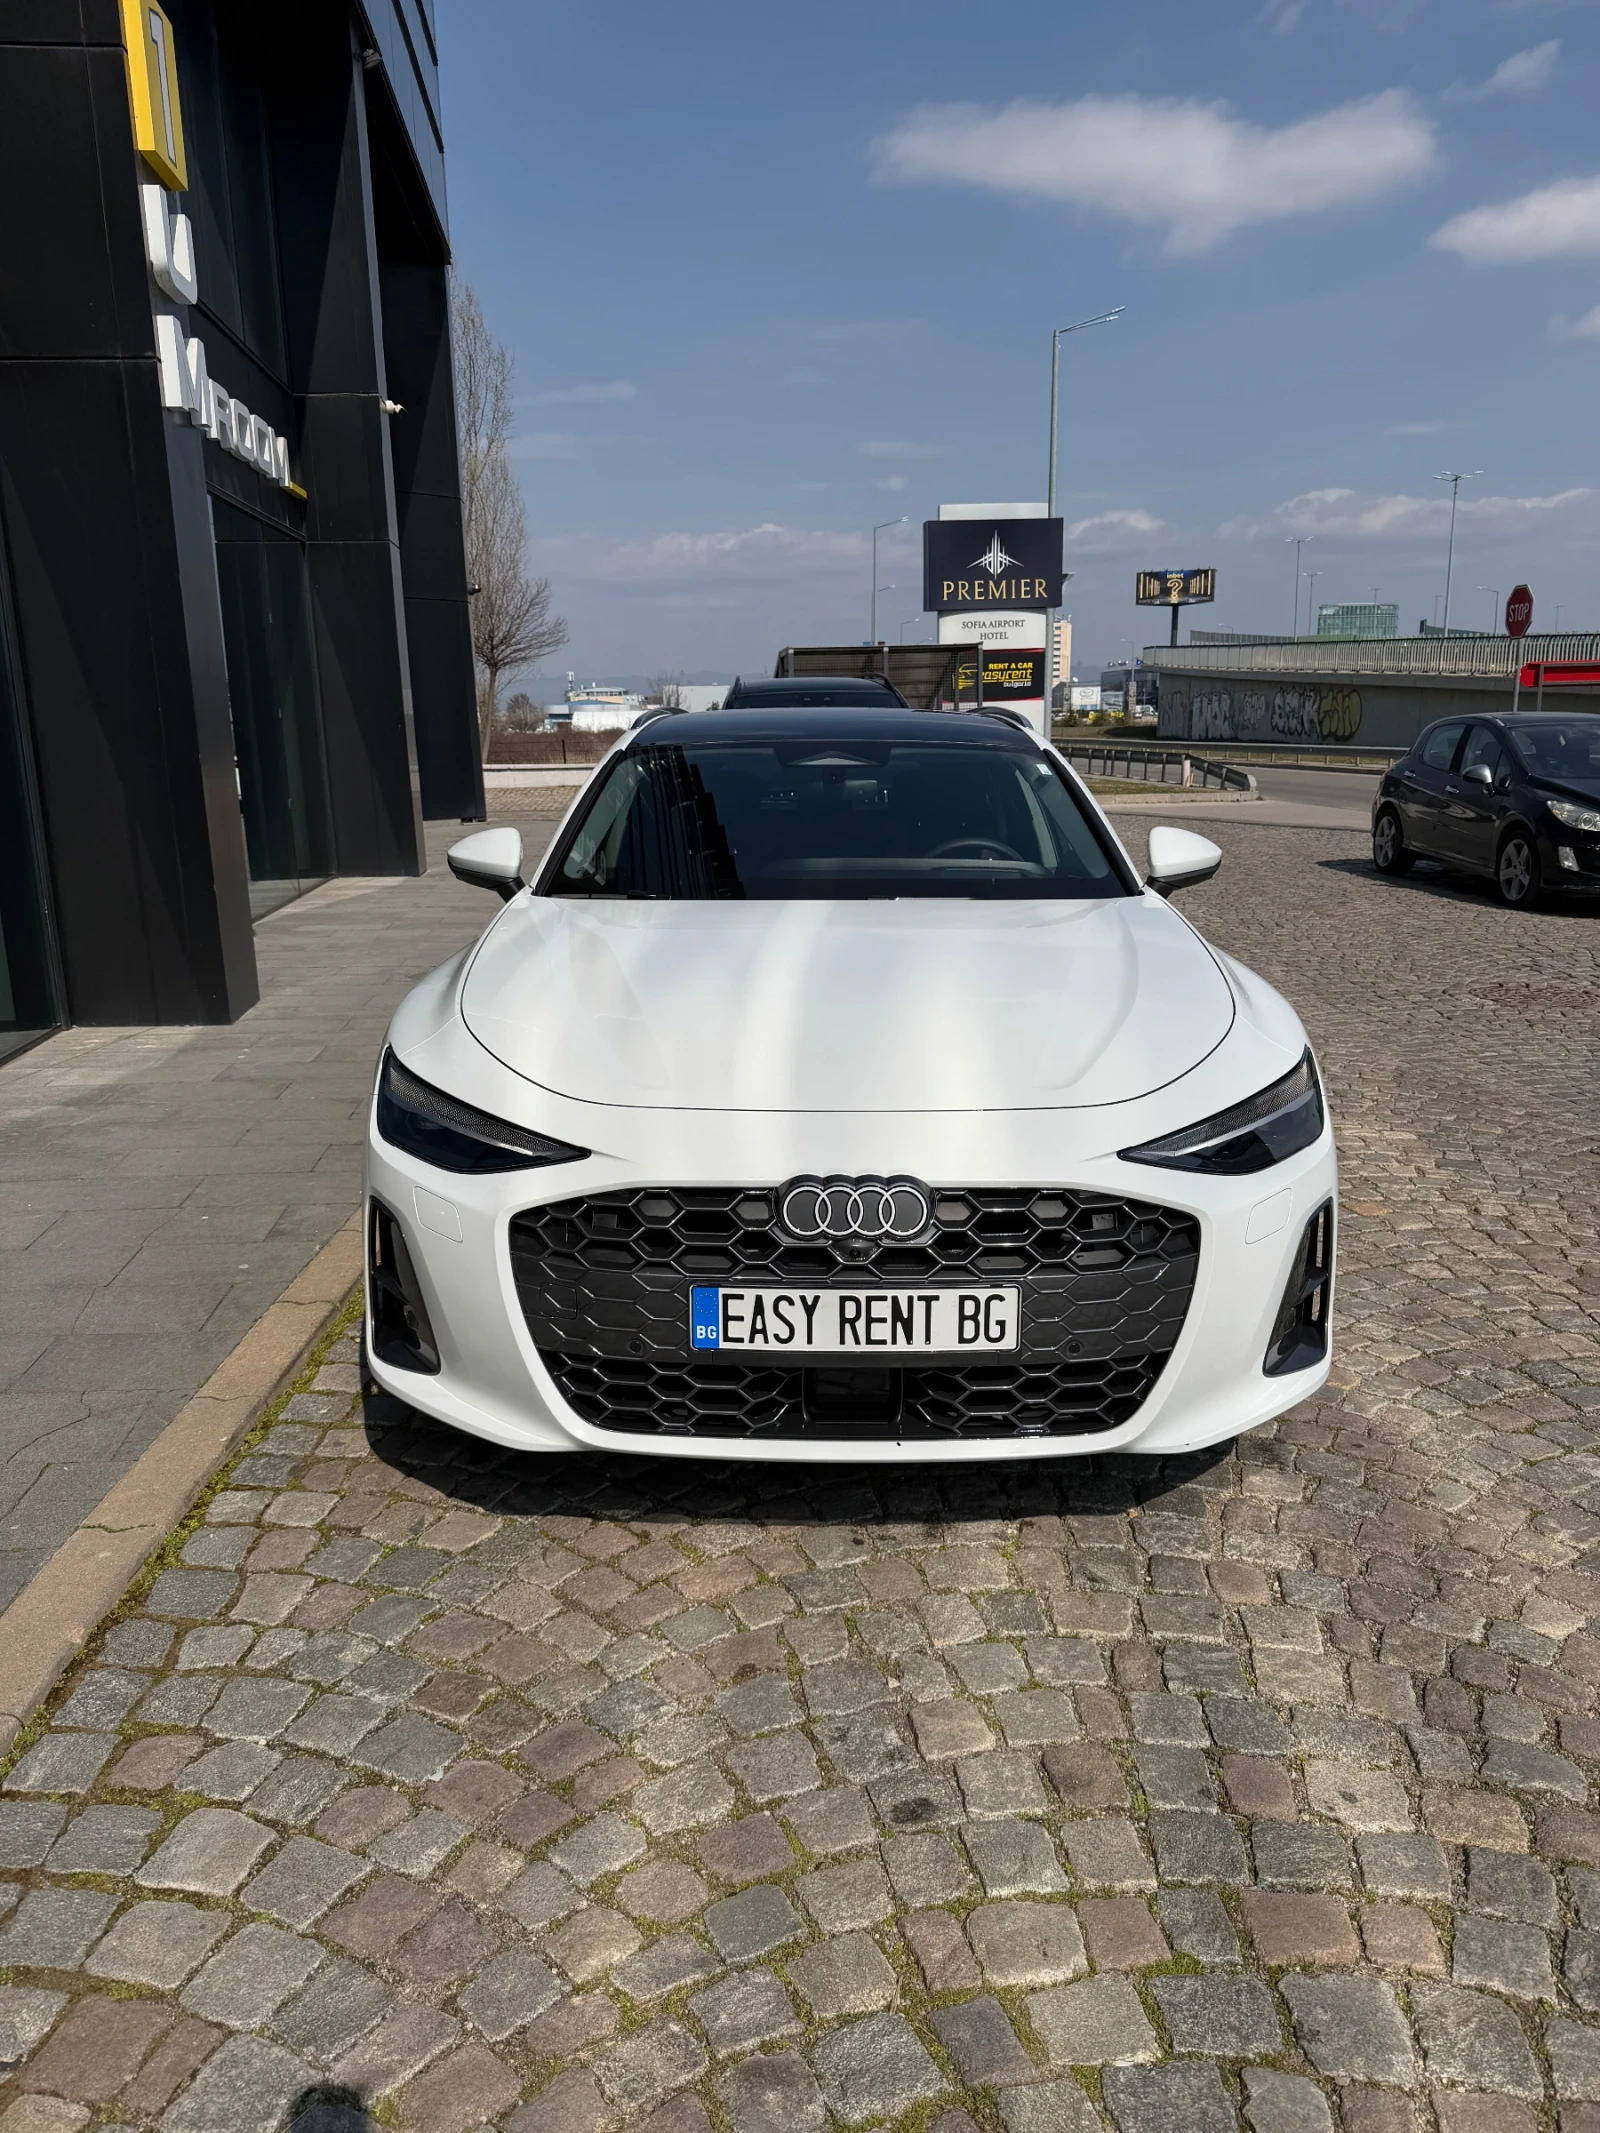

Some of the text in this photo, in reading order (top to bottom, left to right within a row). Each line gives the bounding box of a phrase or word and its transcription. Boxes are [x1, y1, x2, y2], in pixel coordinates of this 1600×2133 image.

[942, 579, 1048, 601] PREMIER
[1509, 603, 1530, 622] STOP
[962, 619, 1025, 629] SOFIA AIRPORT
[980, 632, 1009, 640] HOTEL
[982, 669, 1033, 682] asyrent
[721, 1293, 1007, 1345] EASY RENT BG
[696, 1325, 717, 1340] BG
